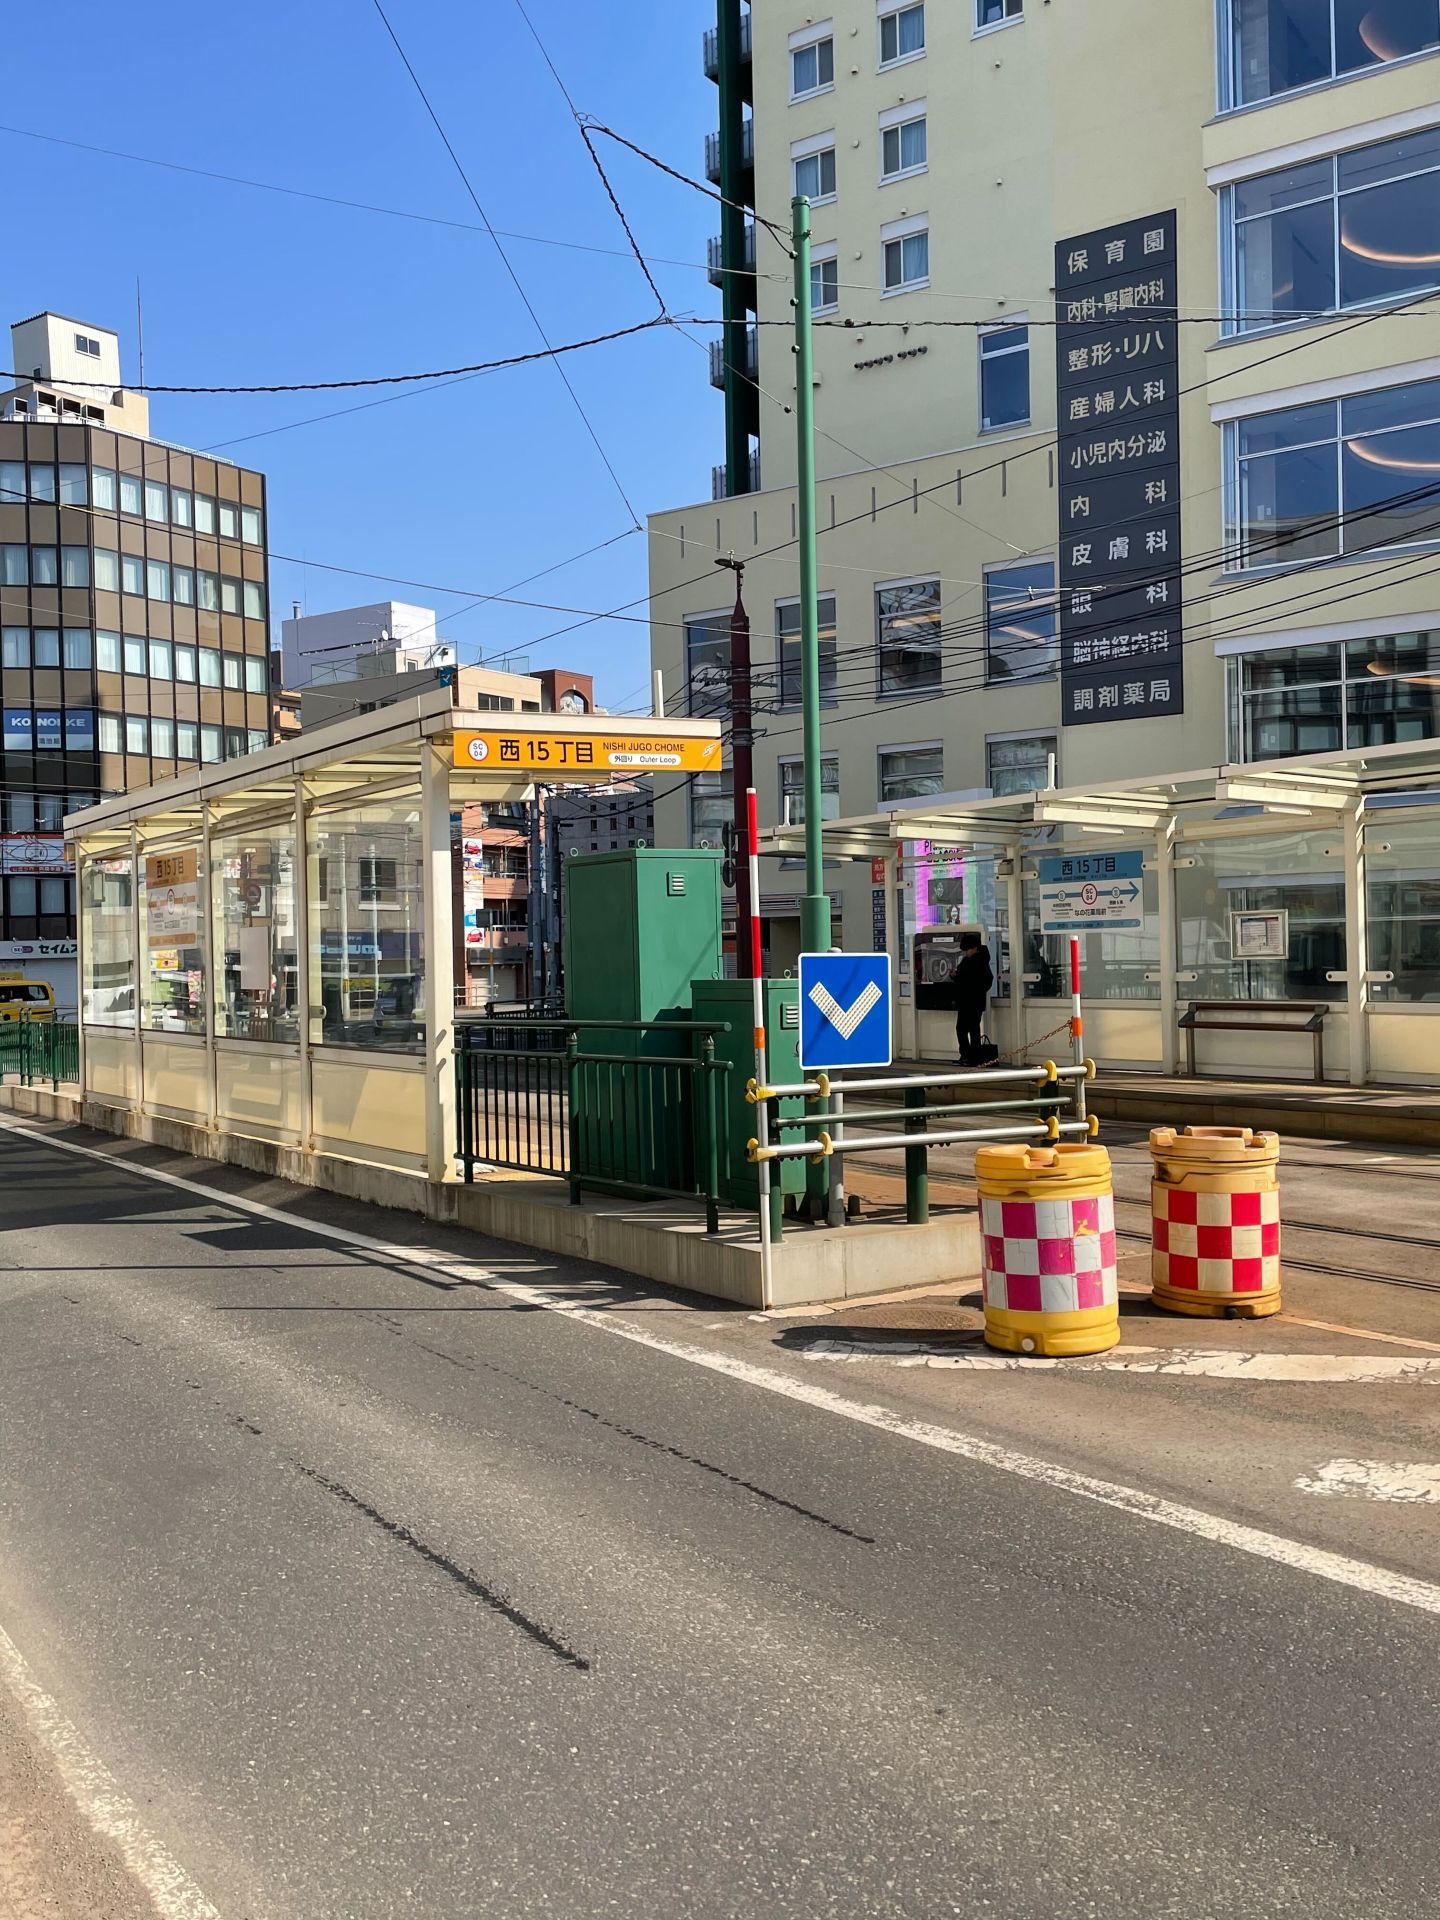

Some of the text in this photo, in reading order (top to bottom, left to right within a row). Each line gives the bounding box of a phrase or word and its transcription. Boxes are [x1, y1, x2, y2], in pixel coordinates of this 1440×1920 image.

[1067, 228, 1165, 274] 保育園
[1068, 330, 1165, 372] 整形・リハ
[1069, 379, 1166, 421] 産婦人科
[1070, 430, 1167, 469] 小児内分泌
[1070, 479, 1168, 518] 内科
[1071, 529, 1168, 566] 皮膚科
[1073, 679, 1171, 712] 調剤薬局
[499, 739, 594, 763] 西15丁目
[602, 742, 685, 752] NISHI JUGO CHOME
[639, 755, 658, 763] Outer
[659, 755, 677, 765] Loop
[1061, 857, 1117, 876] 西15丁目
